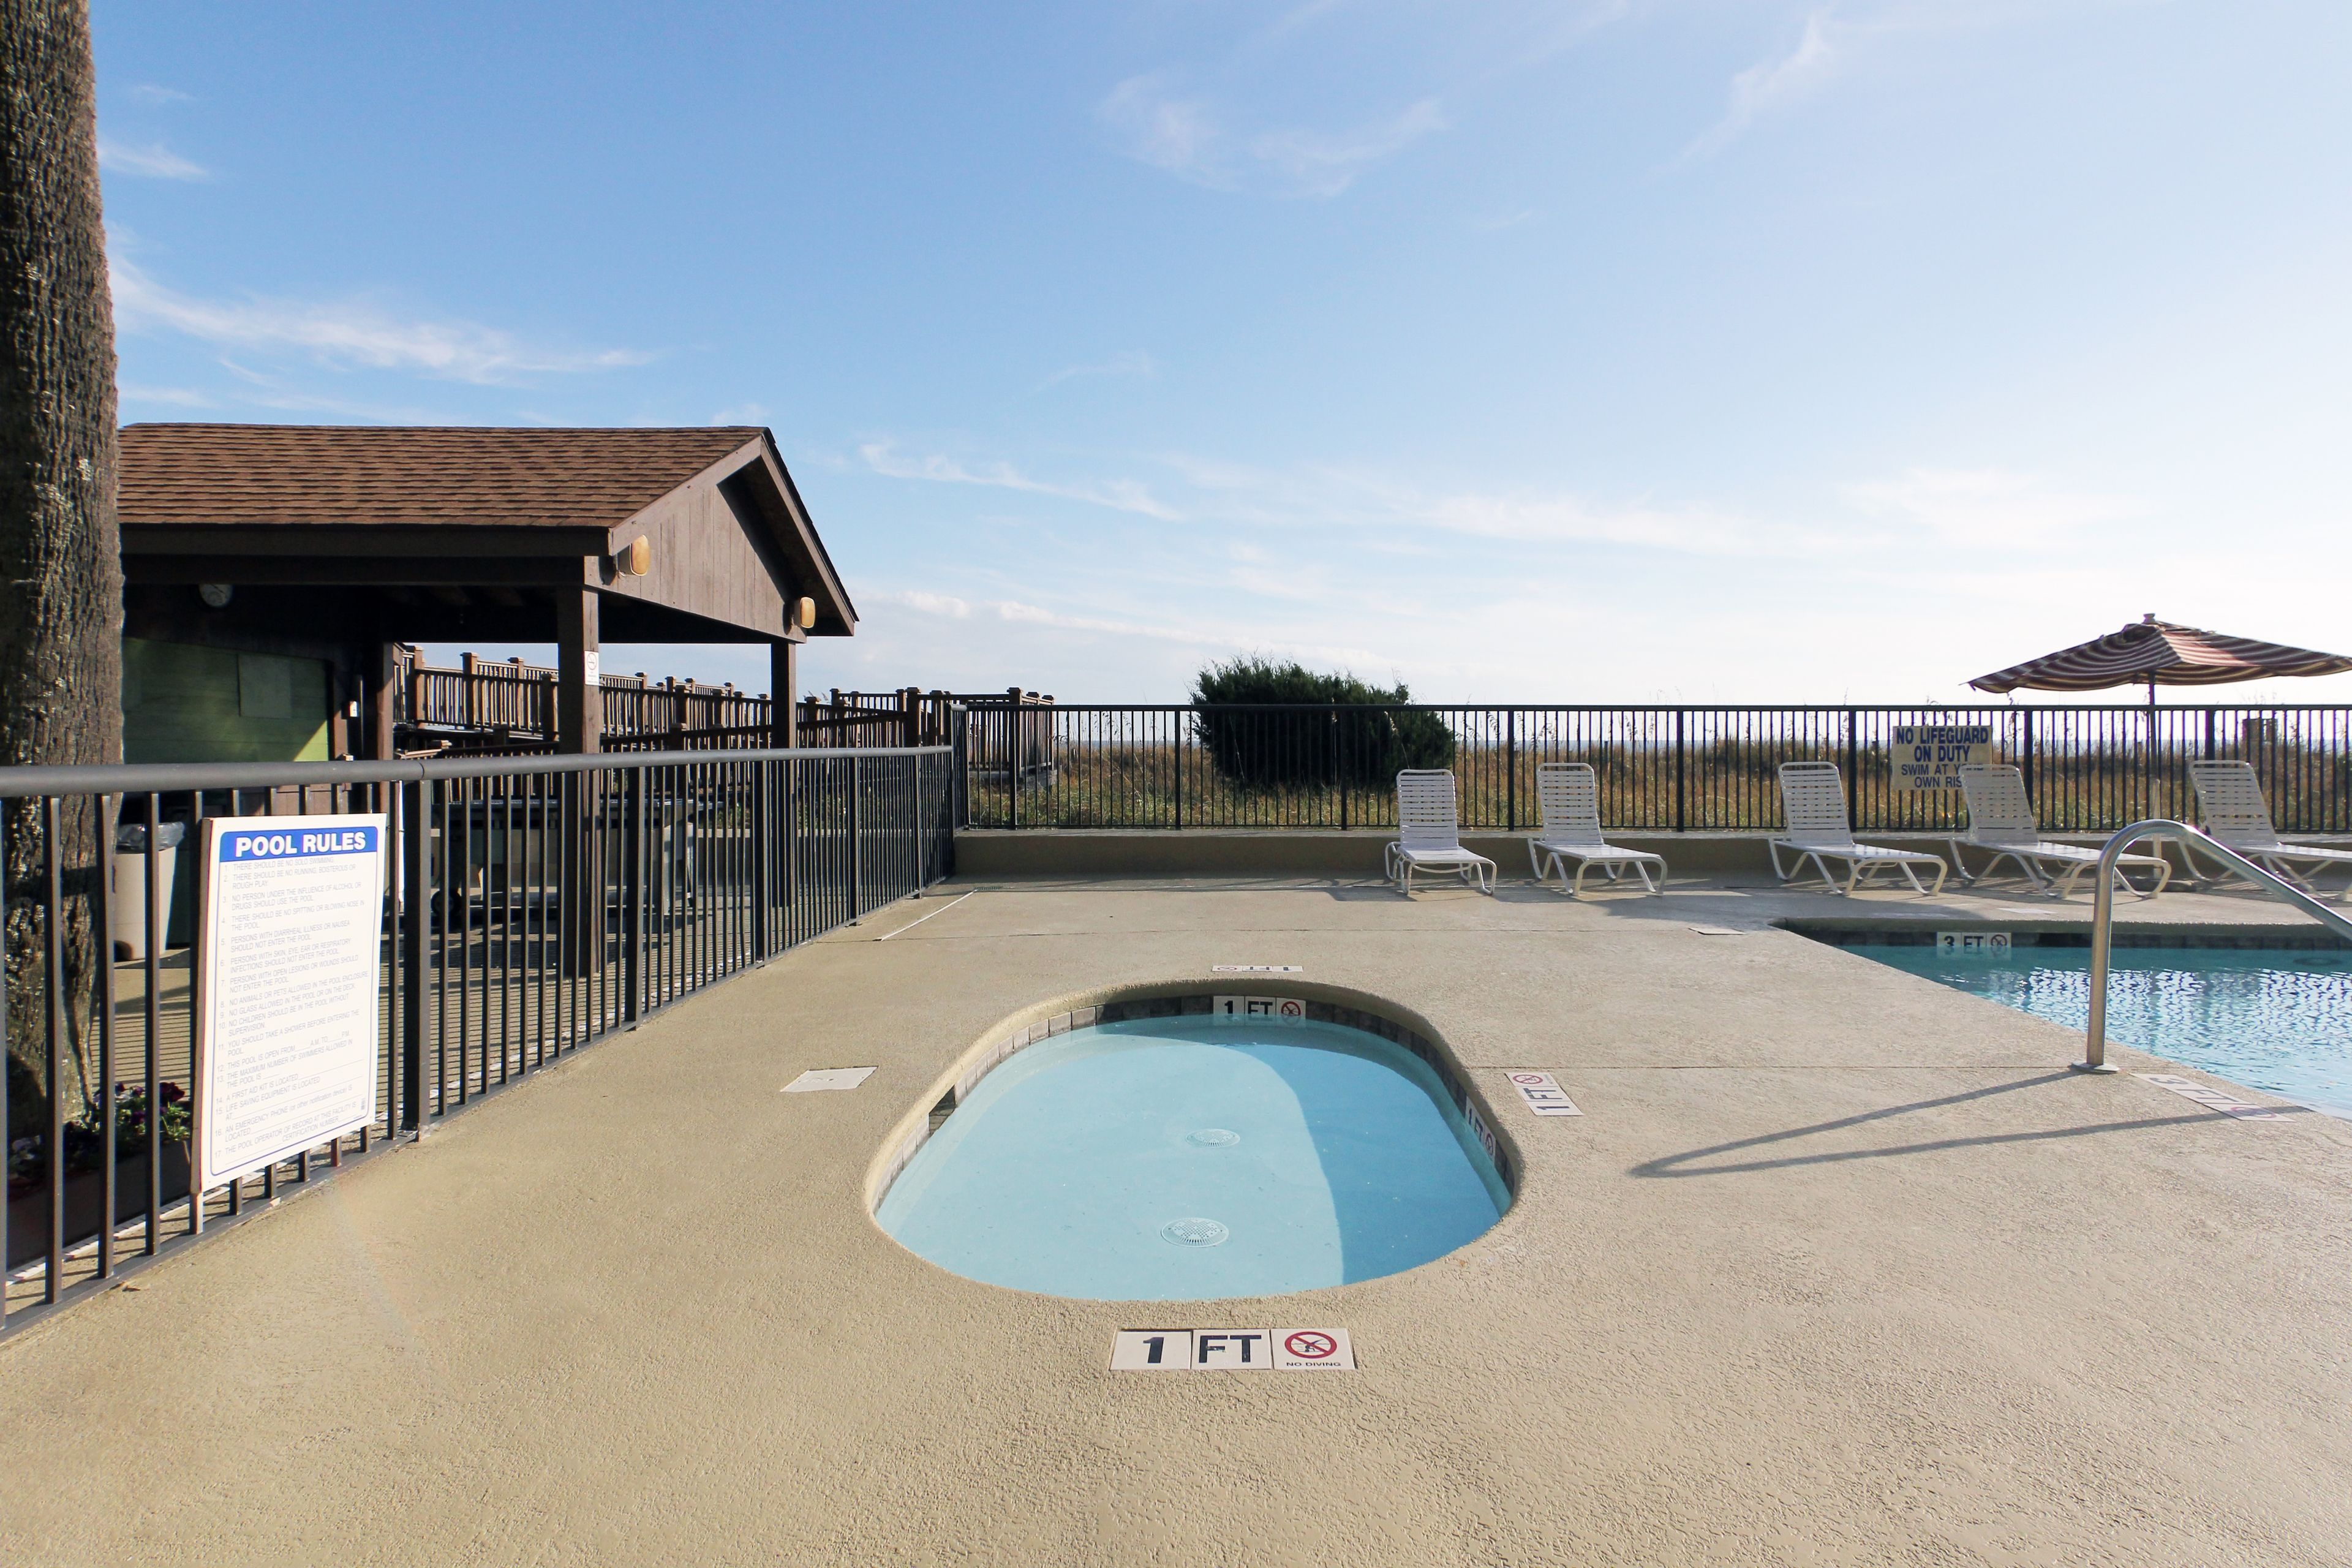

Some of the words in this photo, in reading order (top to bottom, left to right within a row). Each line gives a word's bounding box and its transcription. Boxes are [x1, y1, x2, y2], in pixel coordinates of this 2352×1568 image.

[1896, 728, 1913, 744] NO
[1920, 727, 1989, 744] LIFEGUARD
[1914, 745, 1931, 762] ON
[1938, 745, 1970, 762] DUTY
[1901, 764, 1929, 775] SWIM
[1934, 764, 1948, 775] AT
[1915, 776, 1940, 788] OWN
[1945, 776, 1962, 788] RIS
[235, 835, 298, 857] POOL
[303, 831, 366, 853] RULES
[233, 872, 252, 881] THERE
[254, 870, 274, 879] SHOULD
[242, 892, 264, 901] PERSON
[298, 886, 323, 894] INFLUENCE
[232, 902, 251, 911] DRUGS
[254, 899, 274, 908] SHOULD
[232, 914, 249, 923] THERE
[252, 911, 273, 920] SHOULD
[230, 942, 253, 952] SHOULD
[255, 940, 266, 949] NOT
[268, 937, 285, 946] ENTER
[231, 933, 257, 944] PERSONS
[259, 931, 272, 940] WITH
[1944, 935, 1954, 946] 3
[1964, 936, 1984, 947] FT
[230, 954, 257, 965] PERSONS
[259, 951, 272, 960] WITH
[230, 961, 262, 973] INFECTIONS
[264, 957, 285, 967] SHOULD
[298, 952, 314, 960] ENTER
[230, 974, 256, 985] PERSONS
[258, 971, 271, 979] WITH
[273, 968, 287, 976] OPEN
[288, 963, 309, 973] LESIONS
[341, 954, 358, 963] SHOULD
[230, 985, 241, 993] NOT
[243, 981, 261, 991] ENTER
[239, 993, 262, 1005] ANIMALS
[273, 987, 287, 997] PETS
[288, 982, 311, 993] ALLOWED
[328, 976, 341, 985] POOL
[239, 1004, 257, 1015] GLASS
[258, 998, 283, 1010] ALLOWED
[292, 994, 301, 1003] THE
[302, 991, 315, 1000] POOL
[239, 1012, 266, 1025] CHILDREN
[267, 1007, 288, 1018] SHOULD
[304, 1001, 313, 1009] THE
[315, 998, 328, 1006] POOL
[329, 993, 349, 1003] WITHOUT
[1224, 1000, 1233, 1014] 1
[1248, 1001, 1273, 1015] FT
[228, 1039, 239, 1049] YOU
[242, 1033, 263, 1045] SHOULD
[265, 1030, 278, 1039] TAKE
[284, 1022, 306, 1034] SHOWER
[227, 1060, 239, 1070] THIS
[241, 1055, 256, 1066] POOL
[265, 1049, 279, 1060] OPEN
[281, 1044, 295, 1055] FROM
[227, 1071, 238, 1080] THE
[267, 1056, 288, 1069] NUMBER
[325, 1039, 346, 1052] ALLOWED
[227, 1080, 238, 1089] THE
[239, 1074, 254, 1085] POOL
[232, 1088, 247, 1100] FIRST
[249, 1085, 257, 1095] AID
[276, 1072, 298, 1086] LOCATED
[226, 1102, 238, 1112] LIFE
[239, 1095, 259, 1107] SAVING
[261, 1085, 290, 1101] EQUIPMENT
[298, 1076, 320, 1088] LOCATED
[1523, 1088, 1562, 1099] FT
[235, 1112, 268, 1130] EMERGENCY
[270, 1106, 288, 1118] PHONE
[319, 1115, 338, 1128] NUMBER
[225, 1145, 235, 1155] THE
[238, 1139, 252, 1150] POOL
[254, 1128, 282, 1144] OPERATOR
[292, 1117, 312, 1130] RECORD
[320, 1110, 331, 1120] THIS
[225, 1127, 251, 1142] LOCATED
[1142, 1336, 1164, 1363] 1
[1199, 1335, 1262, 1363] FT
